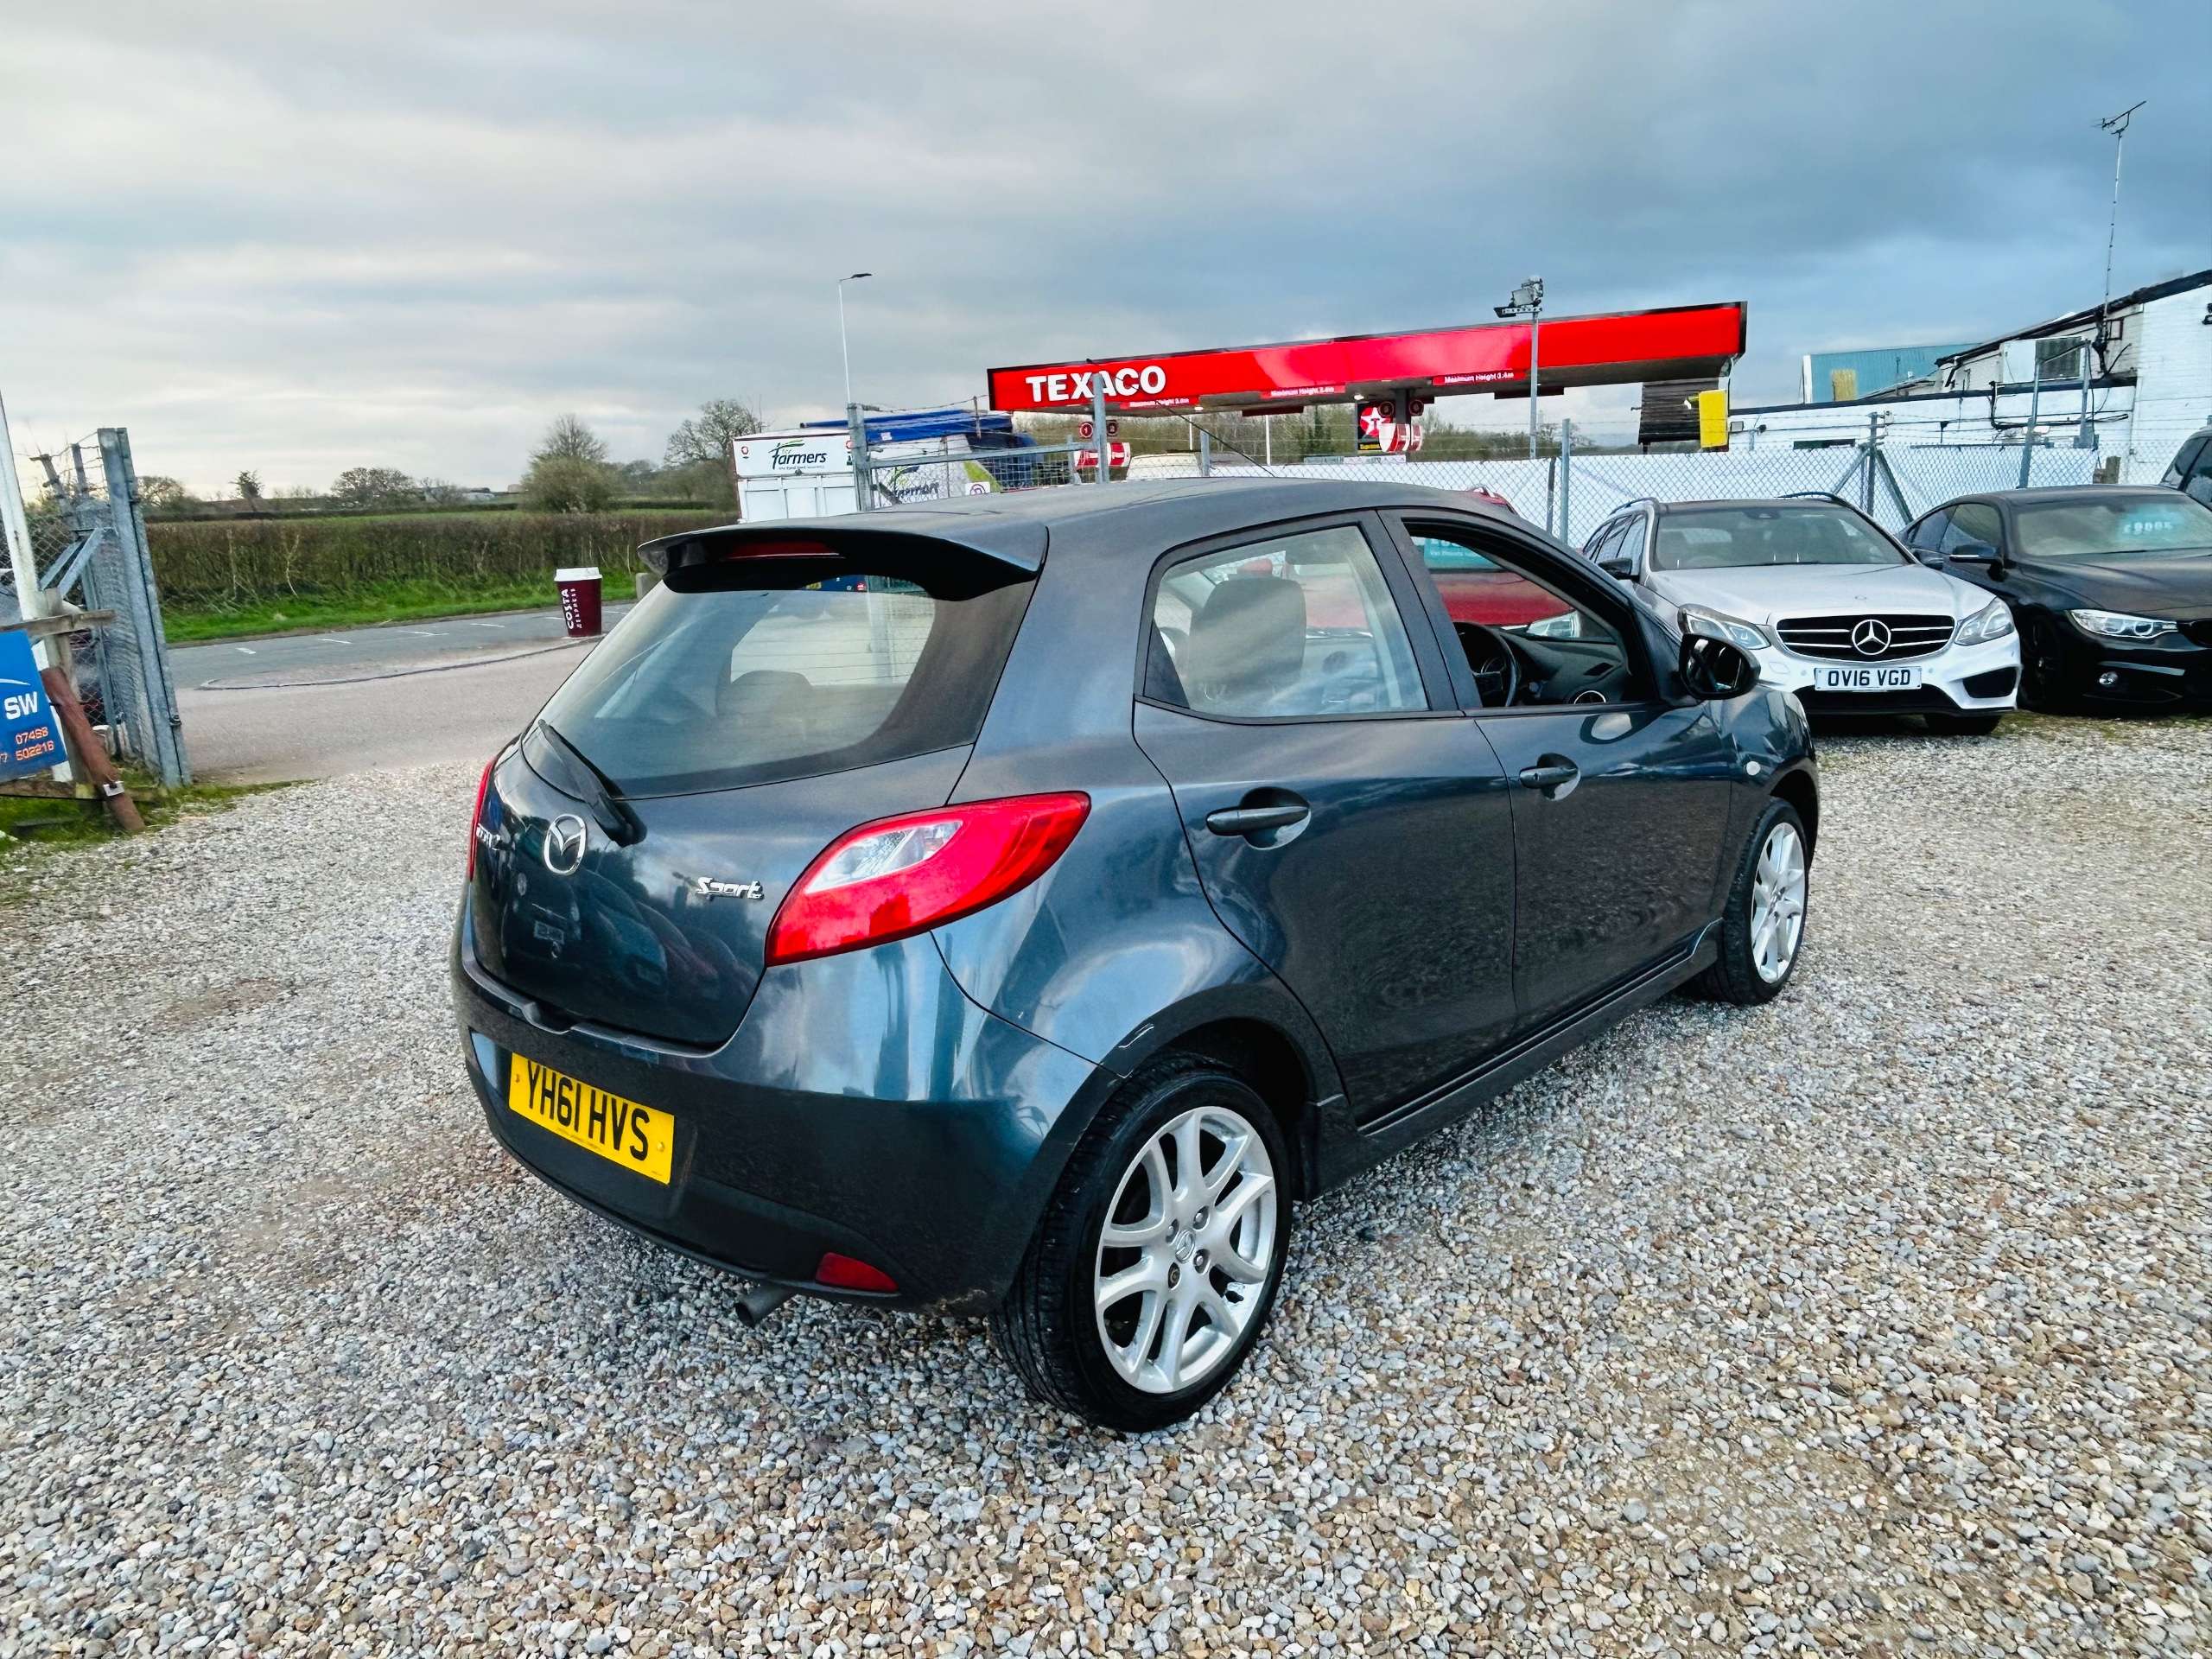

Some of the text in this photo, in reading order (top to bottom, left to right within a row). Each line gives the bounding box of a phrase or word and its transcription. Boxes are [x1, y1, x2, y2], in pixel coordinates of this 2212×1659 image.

[1026, 365, 1166, 402] TEXACO
[561, 588, 574, 630] COSTA
[1827, 669, 1911, 687] OV16 VGD
[3, 690, 38, 720] SW
[696, 876, 765, 901] Sport
[527, 1059, 650, 1161] YH61 HVS
